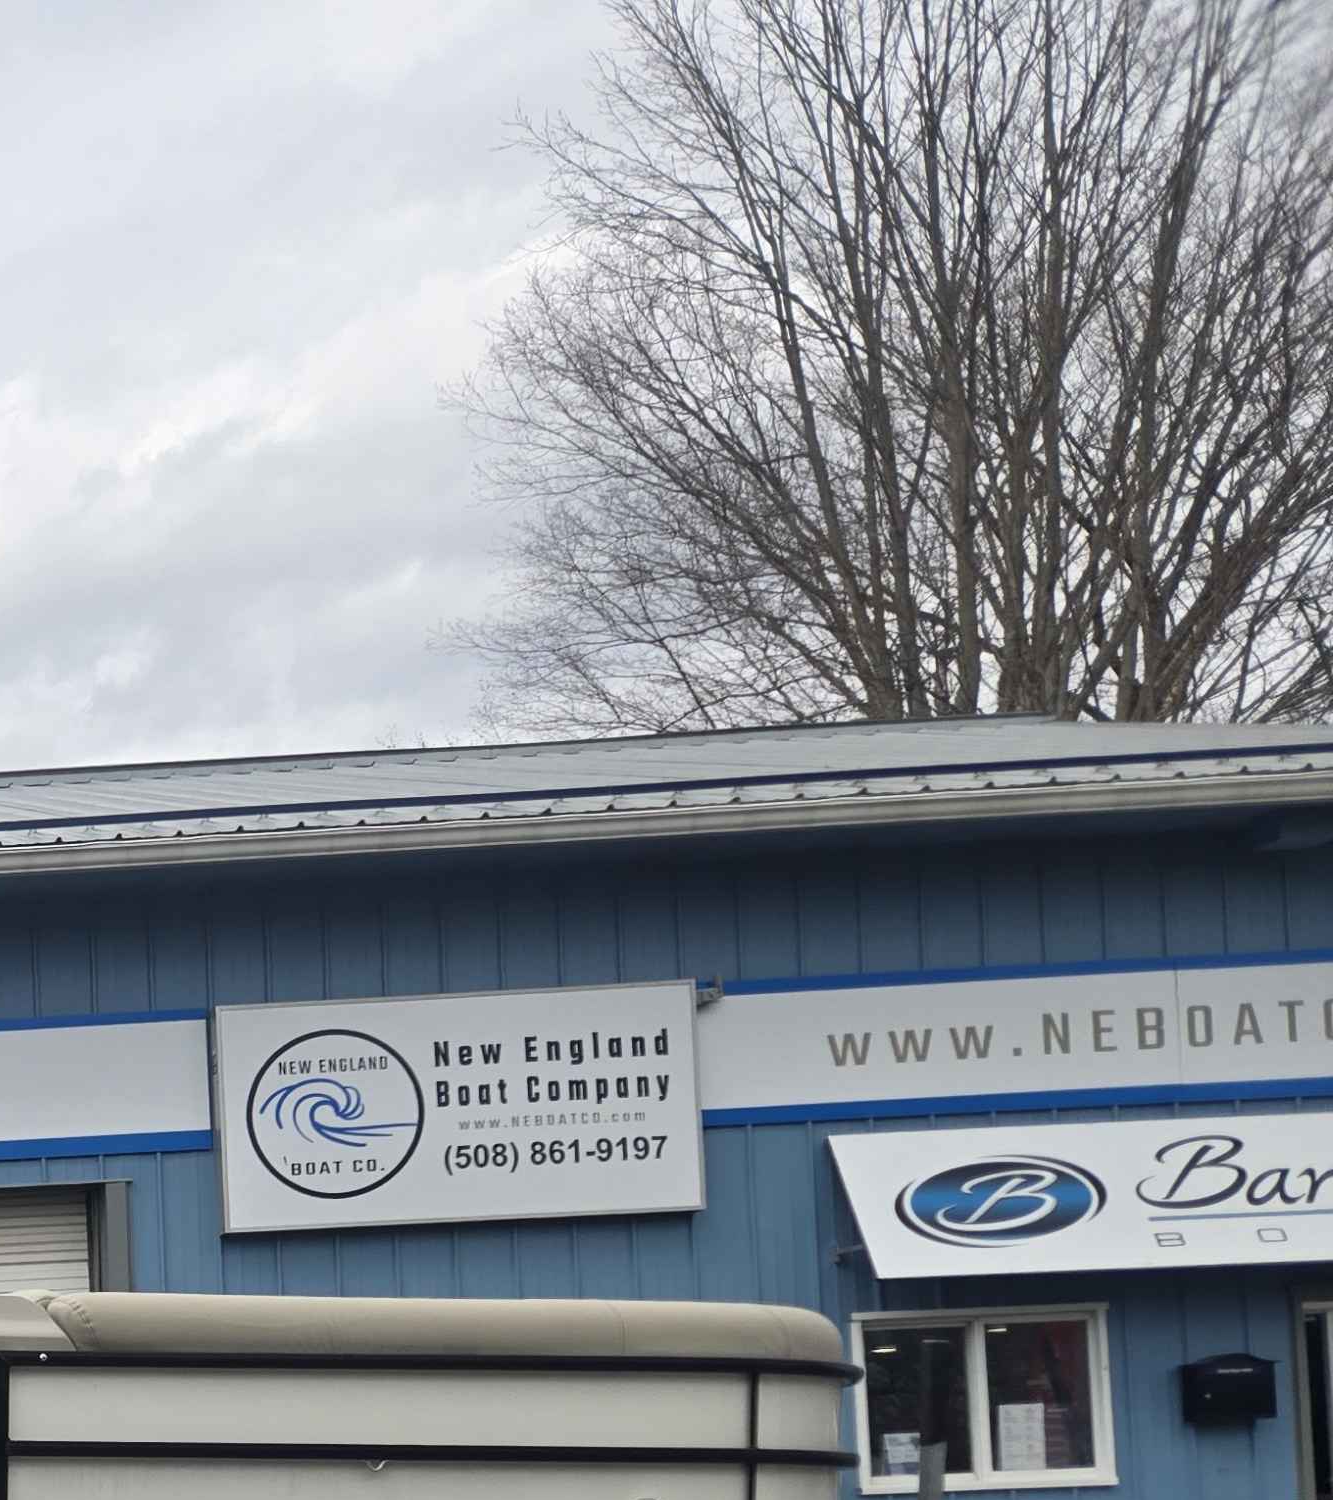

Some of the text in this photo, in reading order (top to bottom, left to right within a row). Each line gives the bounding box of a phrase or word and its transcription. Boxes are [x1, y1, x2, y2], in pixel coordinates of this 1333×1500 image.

[434, 1028, 669, 1067] New England
[278, 1056, 388, 1075] NEW ENGLAND
[436, 1074, 670, 1107] Boat Company
[291, 1158, 386, 1176] BOAT CO.
[444, 1135, 669, 1176] (508) 861-9197
